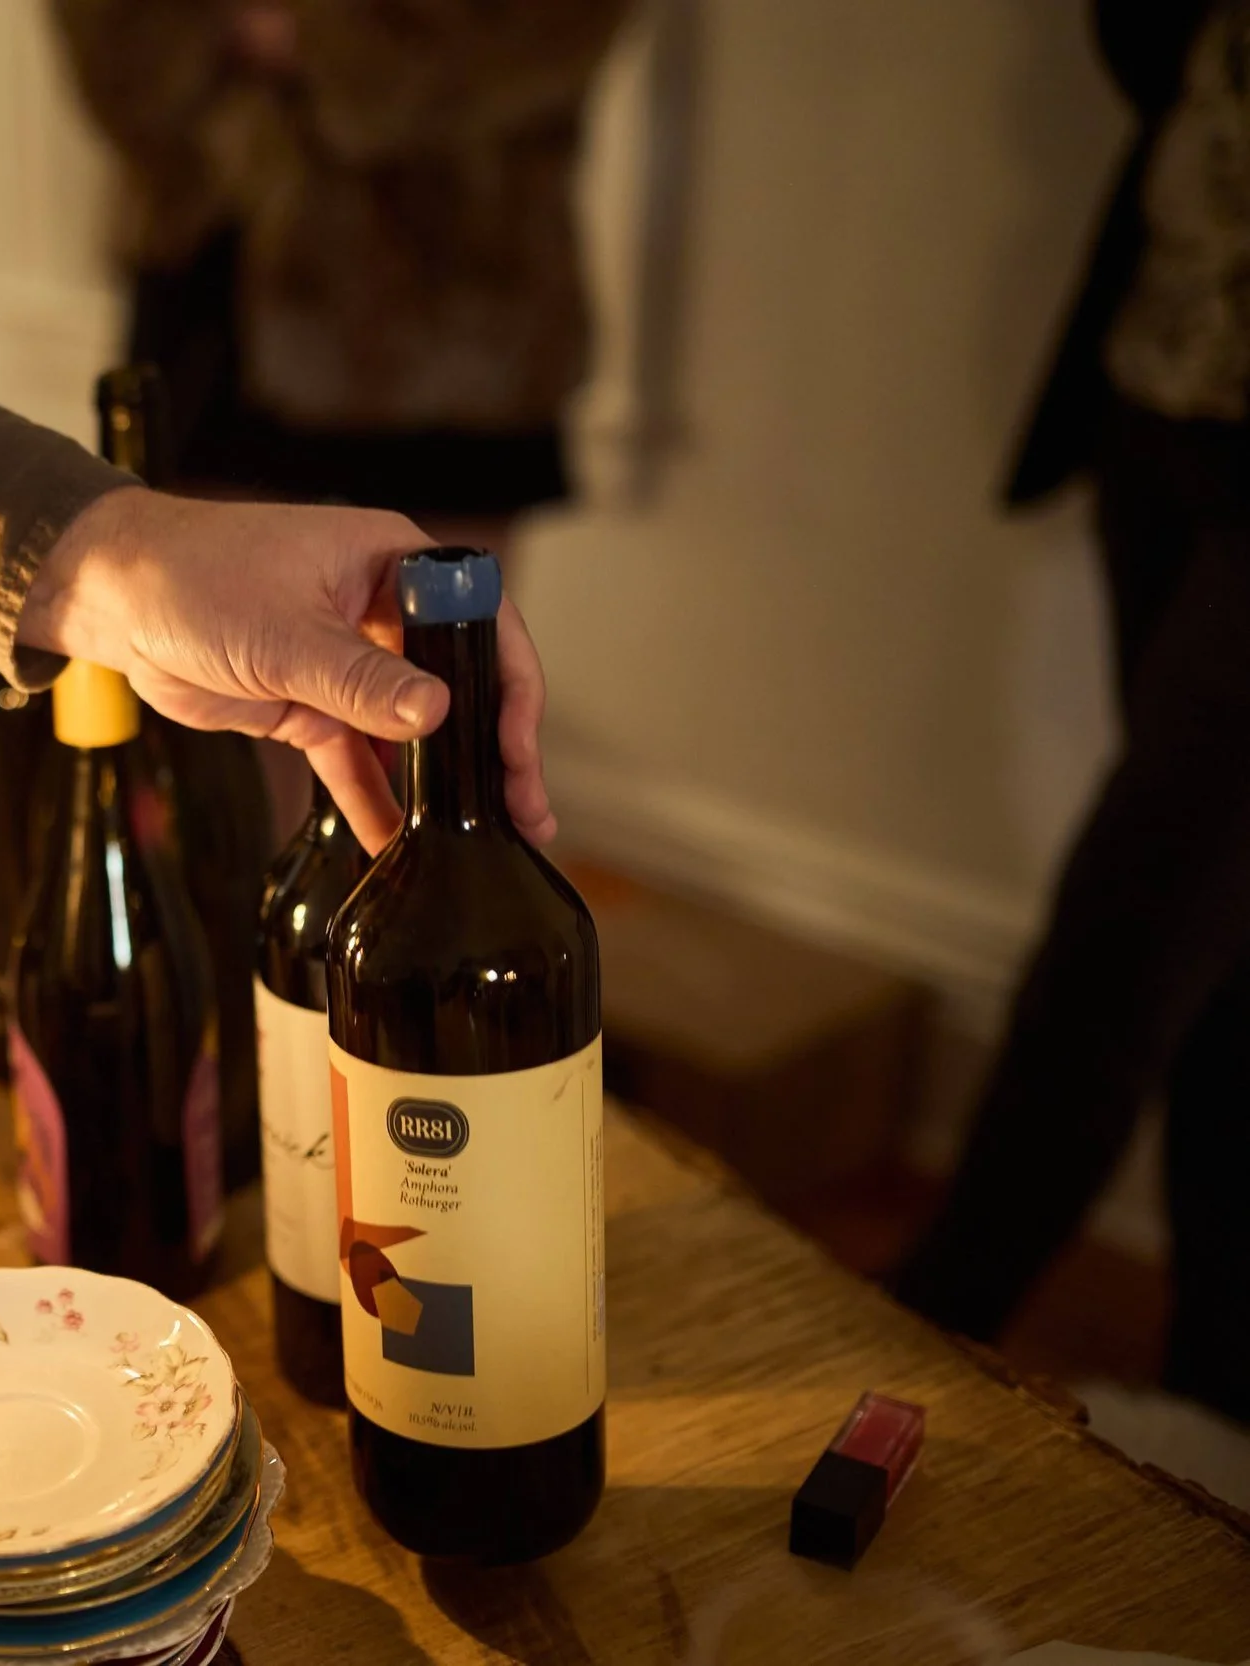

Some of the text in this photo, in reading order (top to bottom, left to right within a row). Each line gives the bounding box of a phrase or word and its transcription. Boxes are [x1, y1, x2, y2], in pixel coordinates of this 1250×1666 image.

[400, 1115, 452, 1141] RR81
[405, 1160, 452, 1178] 'Solera'
[400, 1176, 458, 1195] Amphora
[400, 1191, 462, 1213] Rotburger
